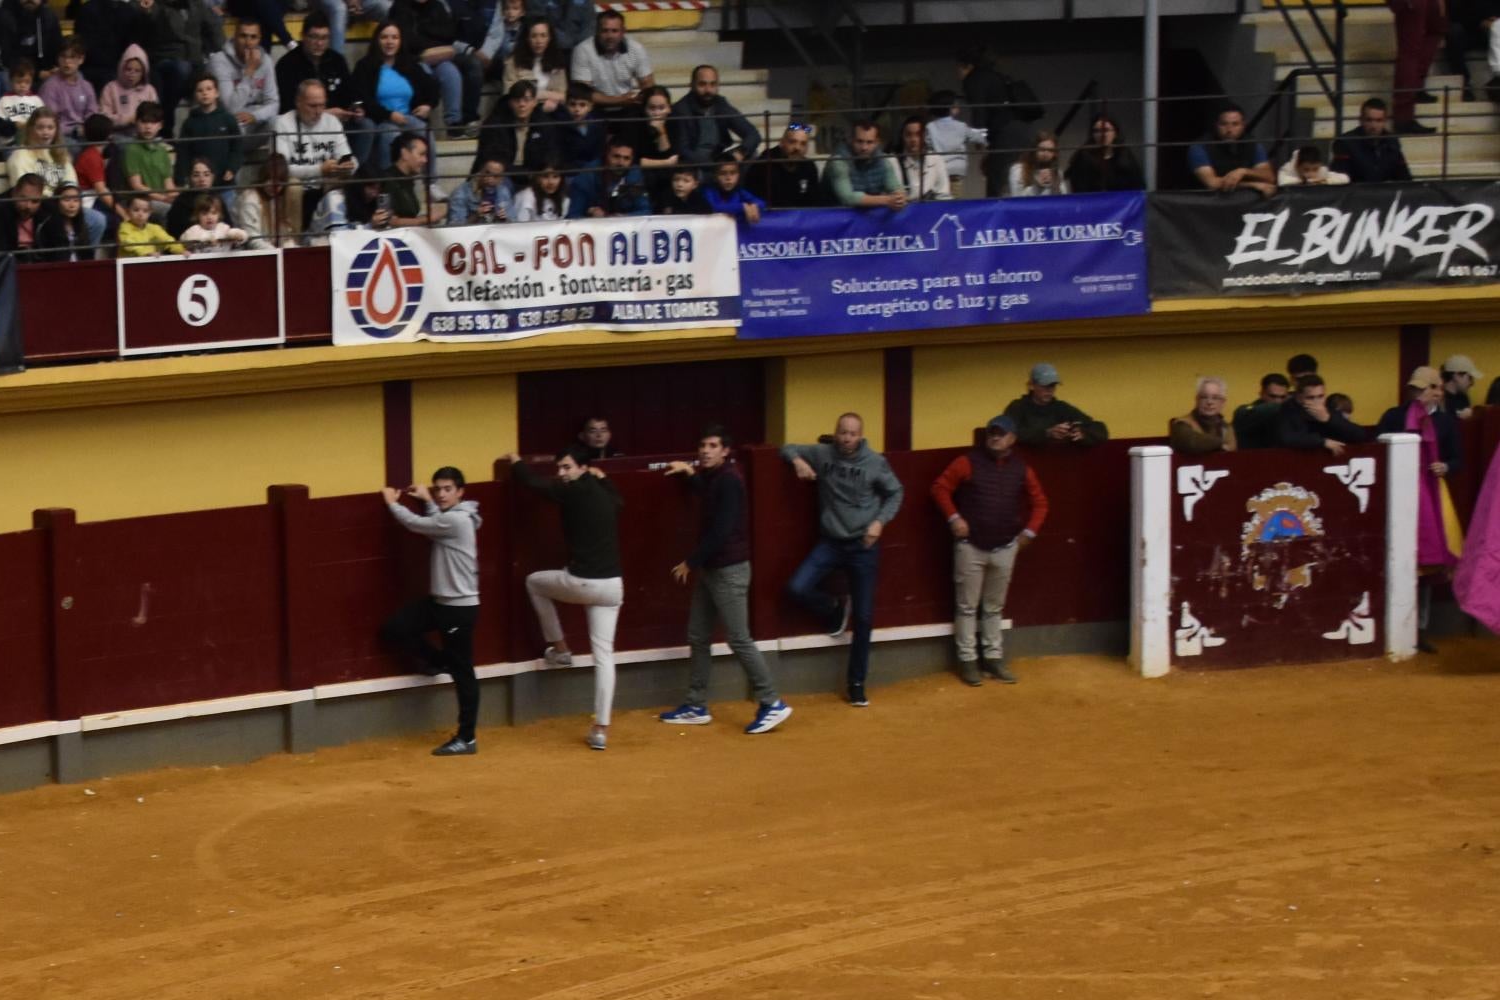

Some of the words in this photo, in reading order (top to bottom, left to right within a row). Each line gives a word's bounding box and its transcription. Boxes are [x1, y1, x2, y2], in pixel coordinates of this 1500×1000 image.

[739, 236, 817, 258] ASESORÍA
[820, 232, 925, 255] ENERGÉTICA
[973, 228, 1020, 246] ALBA
[1023, 227, 1046, 242] DE
[1049, 222, 1123, 241] TORMES
[1225, 207, 1300, 271] EL
[1280, 190, 1494, 278] BUNKER
[443, 239, 506, 276] CAL
[533, 232, 596, 271] FON
[609, 228, 693, 266] ALBA
[447, 276, 544, 302] calefacción
[560, 270, 651, 296] fontanería
[666, 272, 693, 296] gas
[831, 277, 918, 294] Soluciones
[923, 275, 961, 293] para
[965, 272, 984, 286] tu
[988, 269, 1043, 284] ahorro
[188, 279, 208, 322] 5
[612, 303, 642, 321] ALBA
[643, 303, 662, 320] DE
[663, 300, 719, 319] TORMES
[847, 297, 929, 317] energético
[932, 295, 954, 310] de
[958, 293, 984, 309] luz
[985, 296, 997, 310] y
[999, 293, 1029, 310] gas
